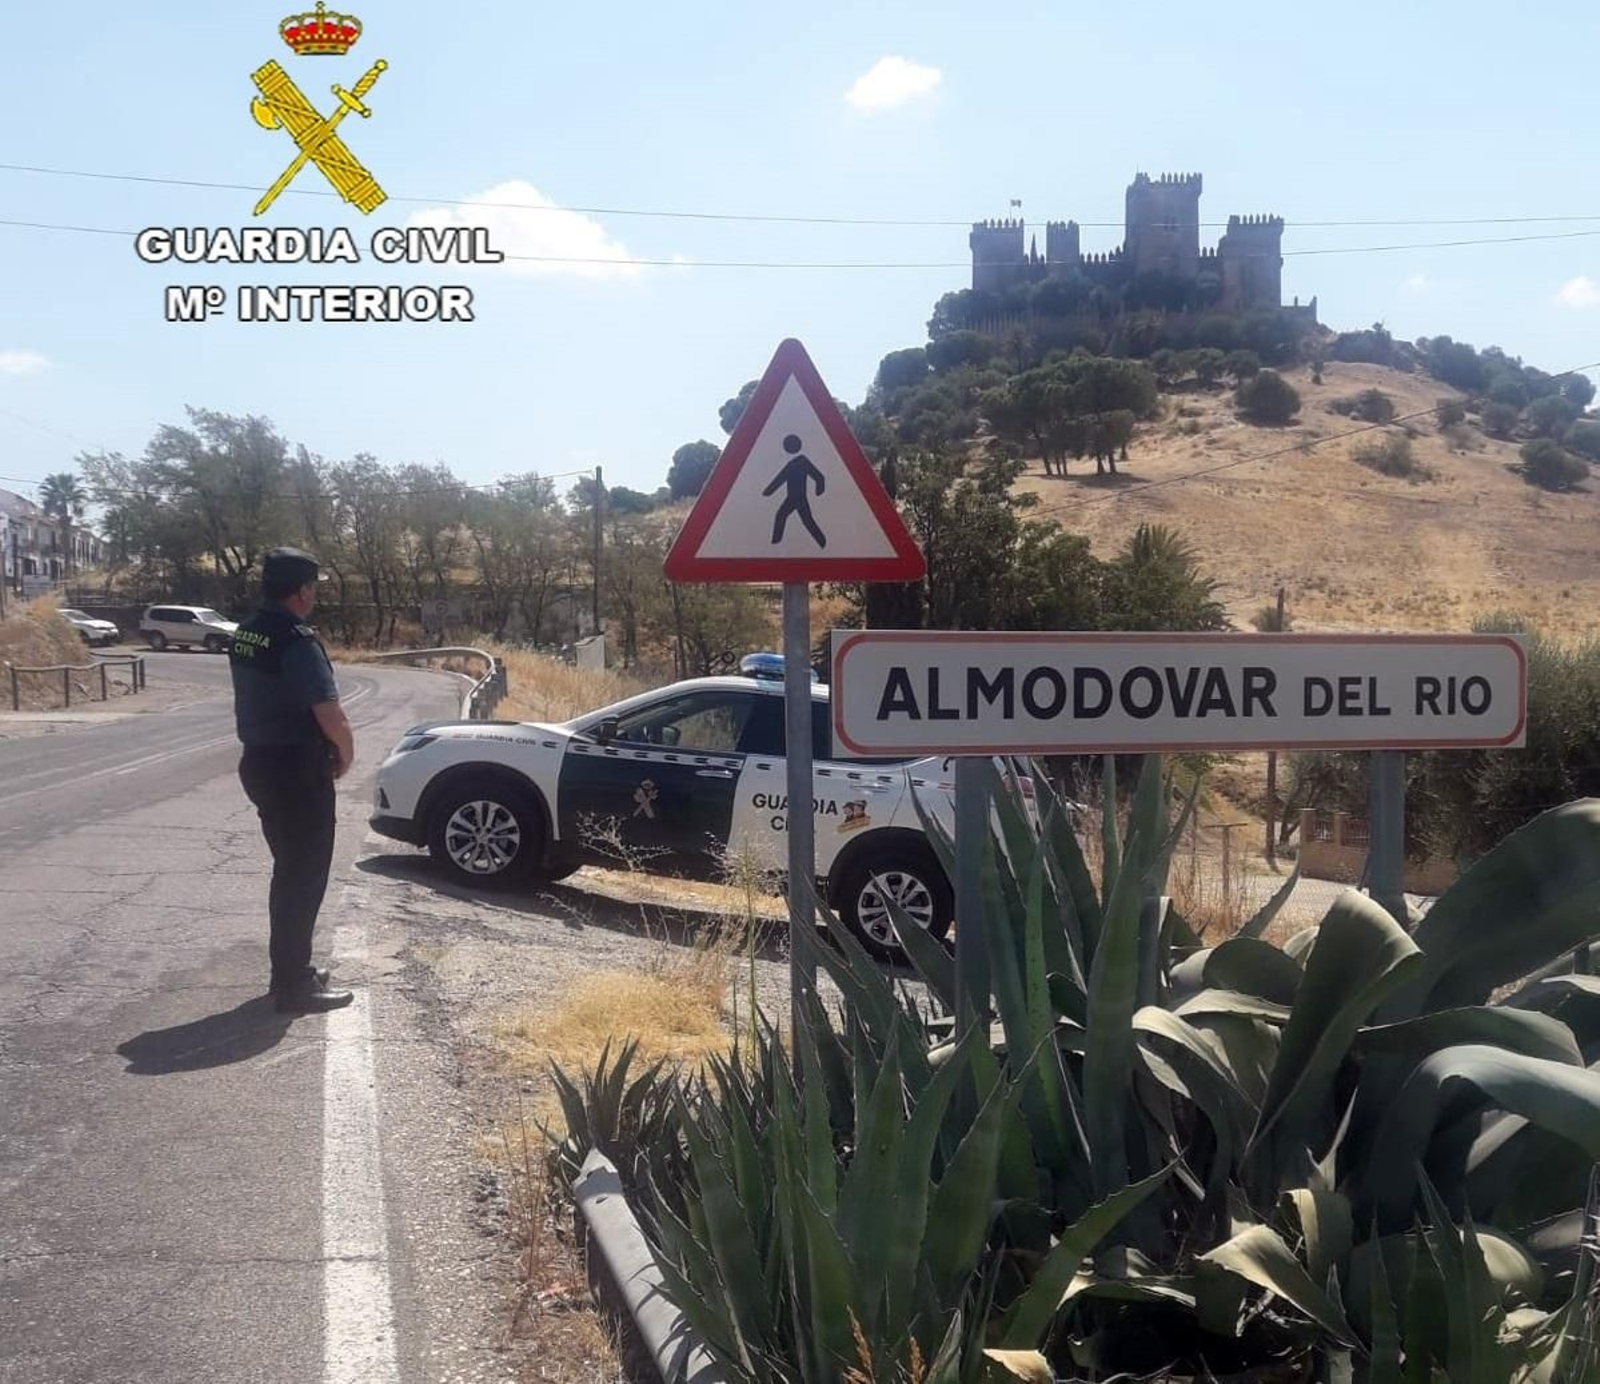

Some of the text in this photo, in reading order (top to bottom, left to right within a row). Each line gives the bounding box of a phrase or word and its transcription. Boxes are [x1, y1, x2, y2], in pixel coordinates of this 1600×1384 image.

[876, 667, 1493, 720] ALMODOVAR DEL RIO
